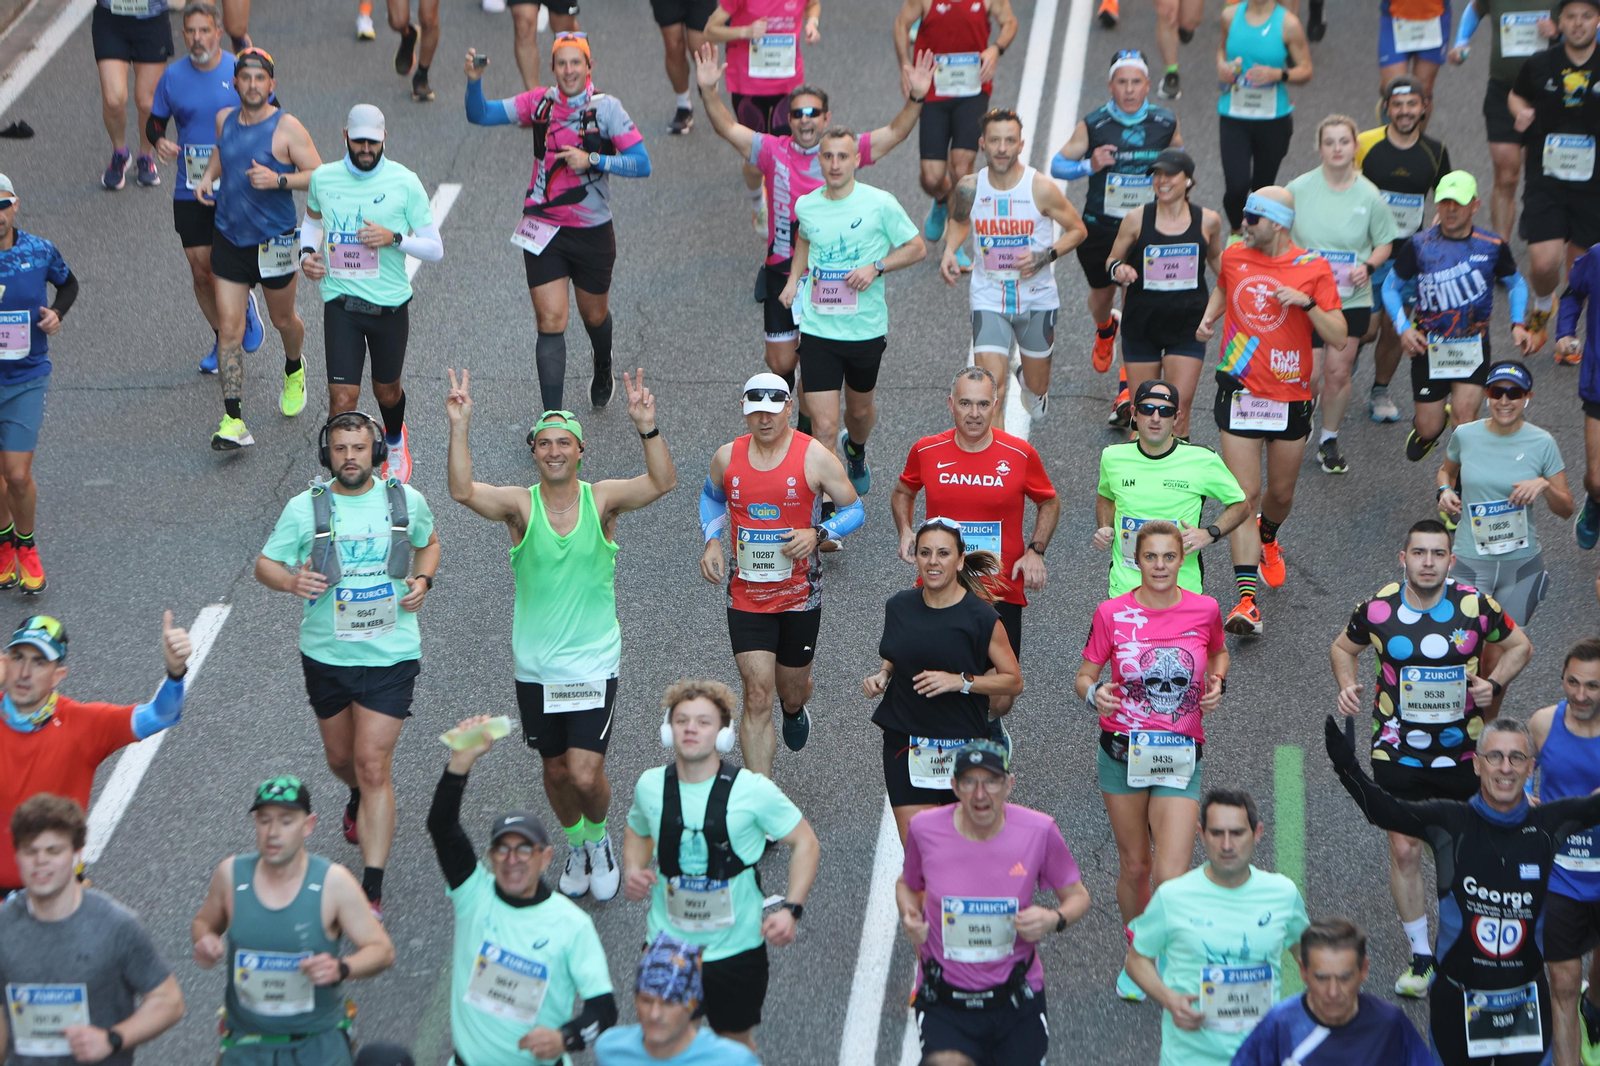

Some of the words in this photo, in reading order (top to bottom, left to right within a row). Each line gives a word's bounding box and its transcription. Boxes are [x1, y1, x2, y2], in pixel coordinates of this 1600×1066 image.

[1563, 138, 1590, 147] ZURICH
[1123, 178, 1151, 186] ZURICH
[996, 238, 1024, 246] ZURICH
[343, 251, 360, 259] 6822
[1163, 246, 1192, 256] ZURICH
[998, 253, 1015, 261] 7635
[1163, 262, 1180, 271] 7244
[822, 287, 839, 295] 7537
[1418, 269, 1489, 312] SEVILLA
[1251, 400, 1269, 409] 6823
[1257, 411, 1284, 419] CARLOTA
[939, 473, 1005, 487] CANADA
[1122, 478, 1136, 487] IAN
[1163, 481, 1190, 490] WOLFPACK
[751, 505, 777, 517] L'aire
[962, 526, 994, 534] ZURICH
[1488, 521, 1510, 532] 10836
[1488, 532, 1515, 542] MARIAM
[752, 551, 775, 560] 10287
[356, 588, 389, 600] ZURICH
[357, 608, 378, 618] 8947
[350, 620, 367, 629] DAN
[367, 619, 385, 627] KEEN
[1424, 671, 1459, 680] ZURICH
[551, 691, 603, 699] TORRESCUSA78
[1424, 690, 1446, 699] 9538
[1407, 702, 1451, 710] MELONARES
[933, 738, 965, 748] ZURICH
[1153, 735, 1187, 744] ZURICH
[1153, 756, 1175, 764] 9435
[1567, 848, 1590, 858] JULIO
[1463, 876, 1533, 909] George
[968, 902, 1008, 913] ZURICH
[1481, 922, 1518, 945] 30
[502, 953, 544, 977] ZURICH
[1228, 970, 1266, 983] ZURICH
[1492, 988, 1528, 1006] ZURICH
